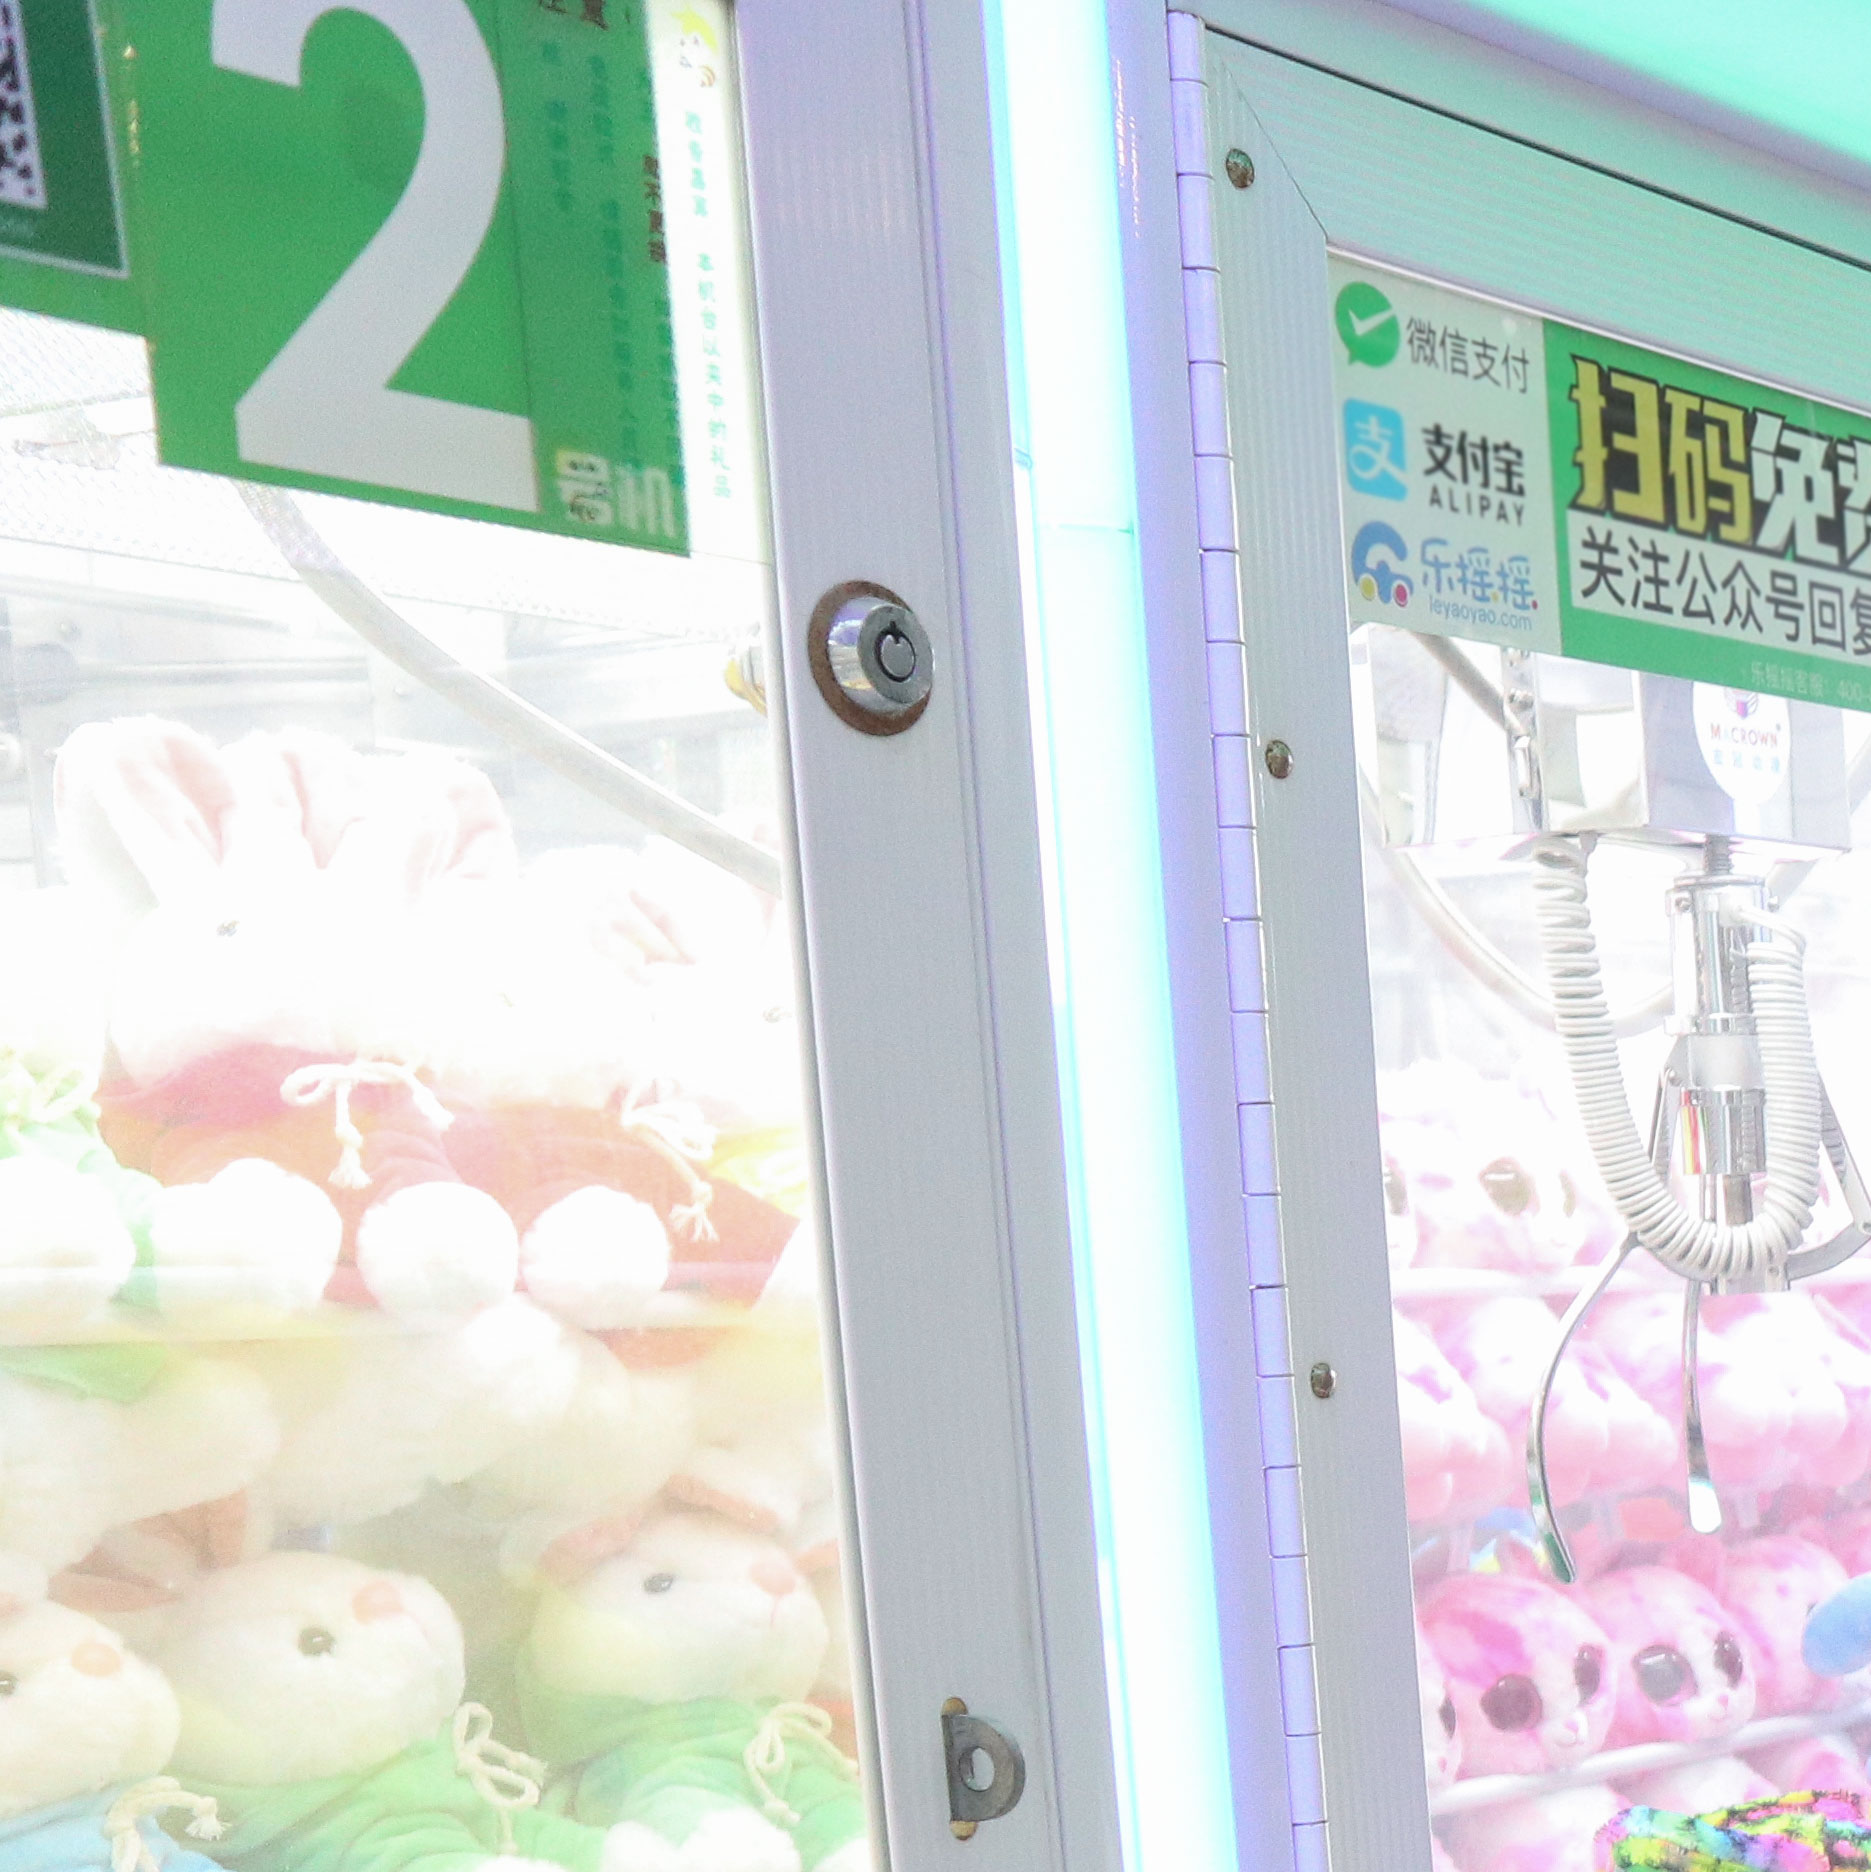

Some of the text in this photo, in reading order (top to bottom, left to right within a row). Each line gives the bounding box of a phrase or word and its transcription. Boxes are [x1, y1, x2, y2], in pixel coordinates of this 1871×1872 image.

[210, 0, 541, 513] 2
[1405, 315, 1530, 395] 微信支付
[1420, 422, 1526, 498] 支付宝
[1429, 484, 1526, 528] ALIPAY
[1419, 537, 1538, 611] 乐摇摇
[1428, 594, 1533, 633] leyaoyao.com
